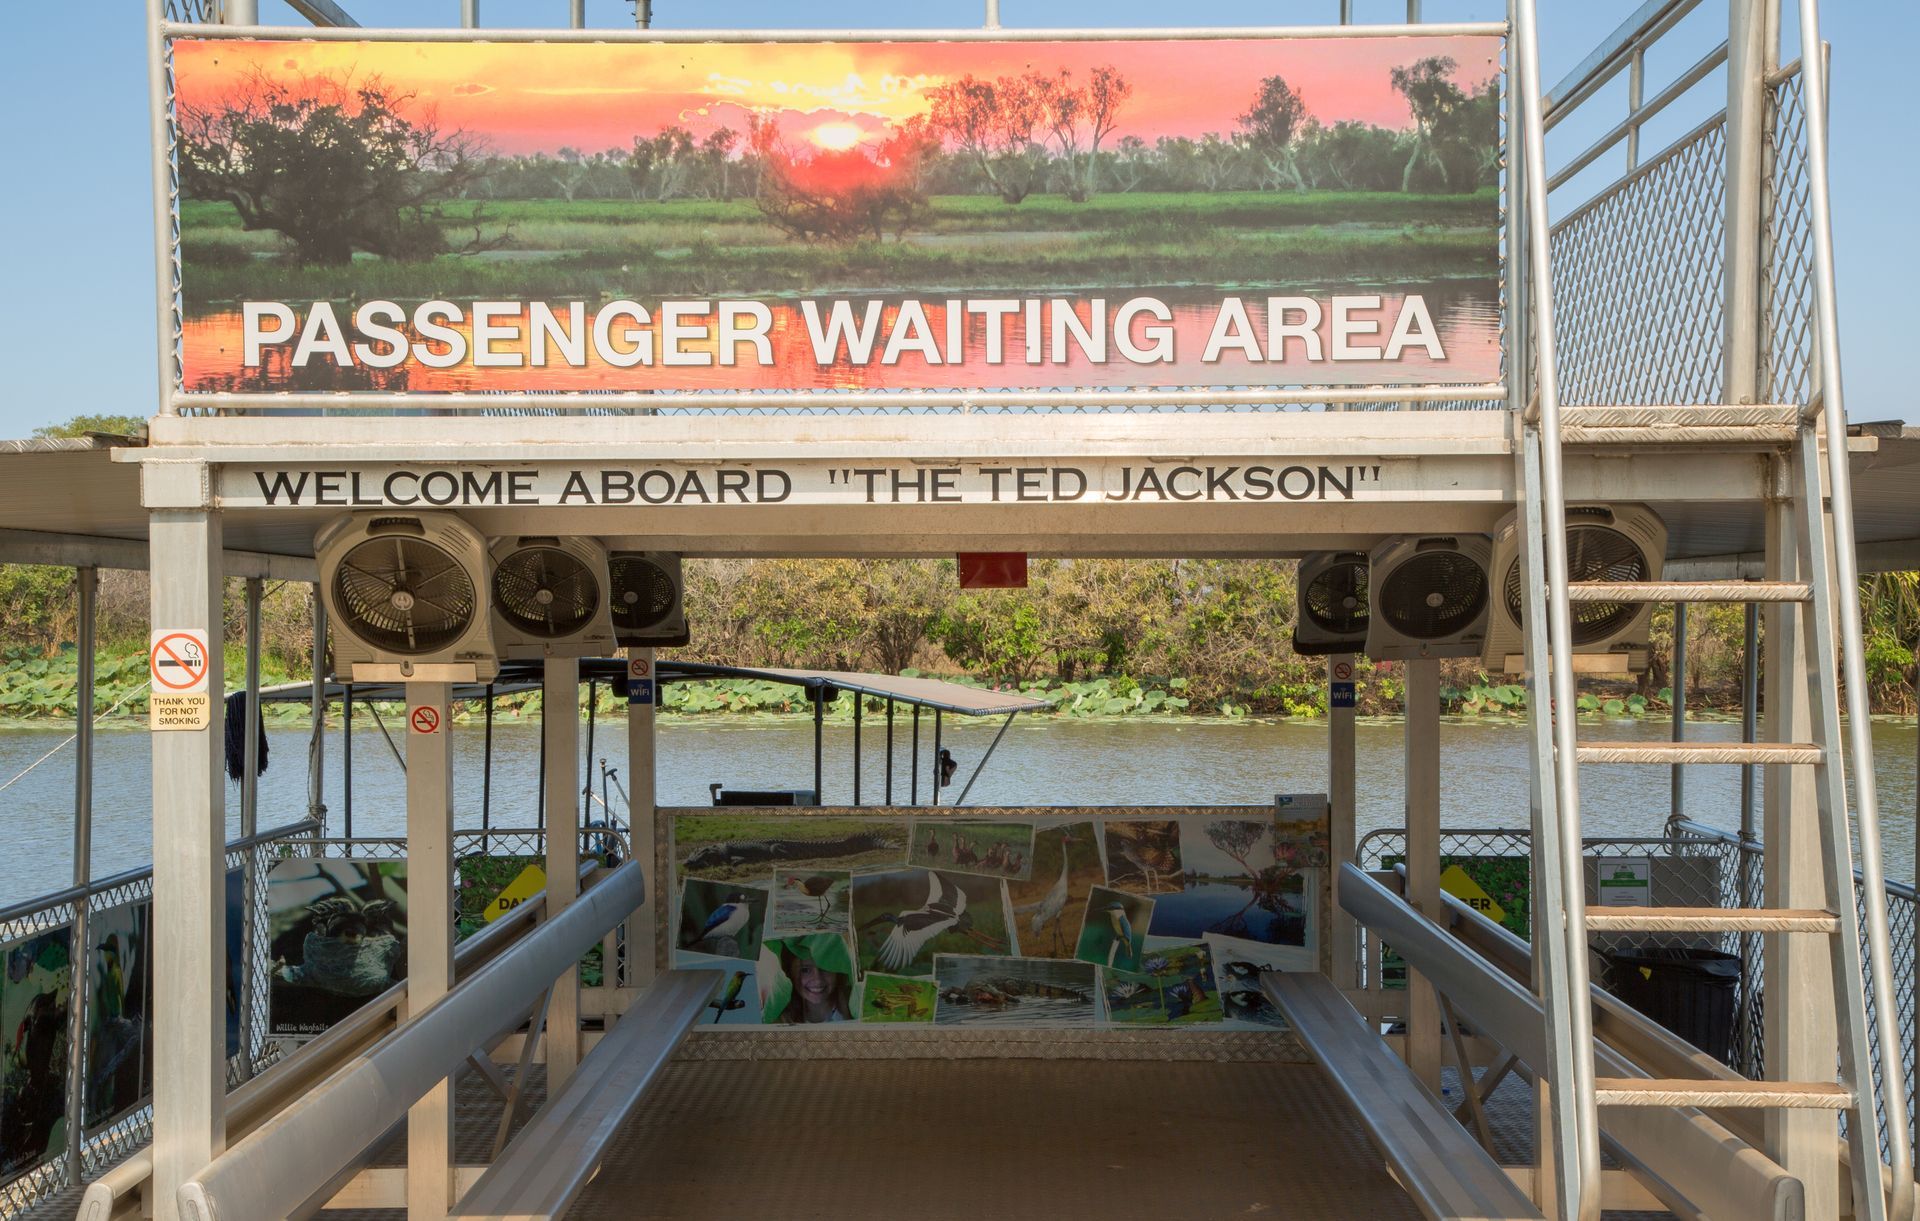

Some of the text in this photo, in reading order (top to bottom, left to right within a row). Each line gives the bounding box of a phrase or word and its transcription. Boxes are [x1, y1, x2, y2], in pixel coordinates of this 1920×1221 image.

[242, 295, 1447, 367] PASSENGER WAITING AREA
[254, 466, 1381, 506] WELCOME ABOARD "THE TED JACKSON"
[631, 687, 650, 697] WiFi
[153, 697, 205, 705] THANK YOU
[159, 717, 200, 725] SMOKING
